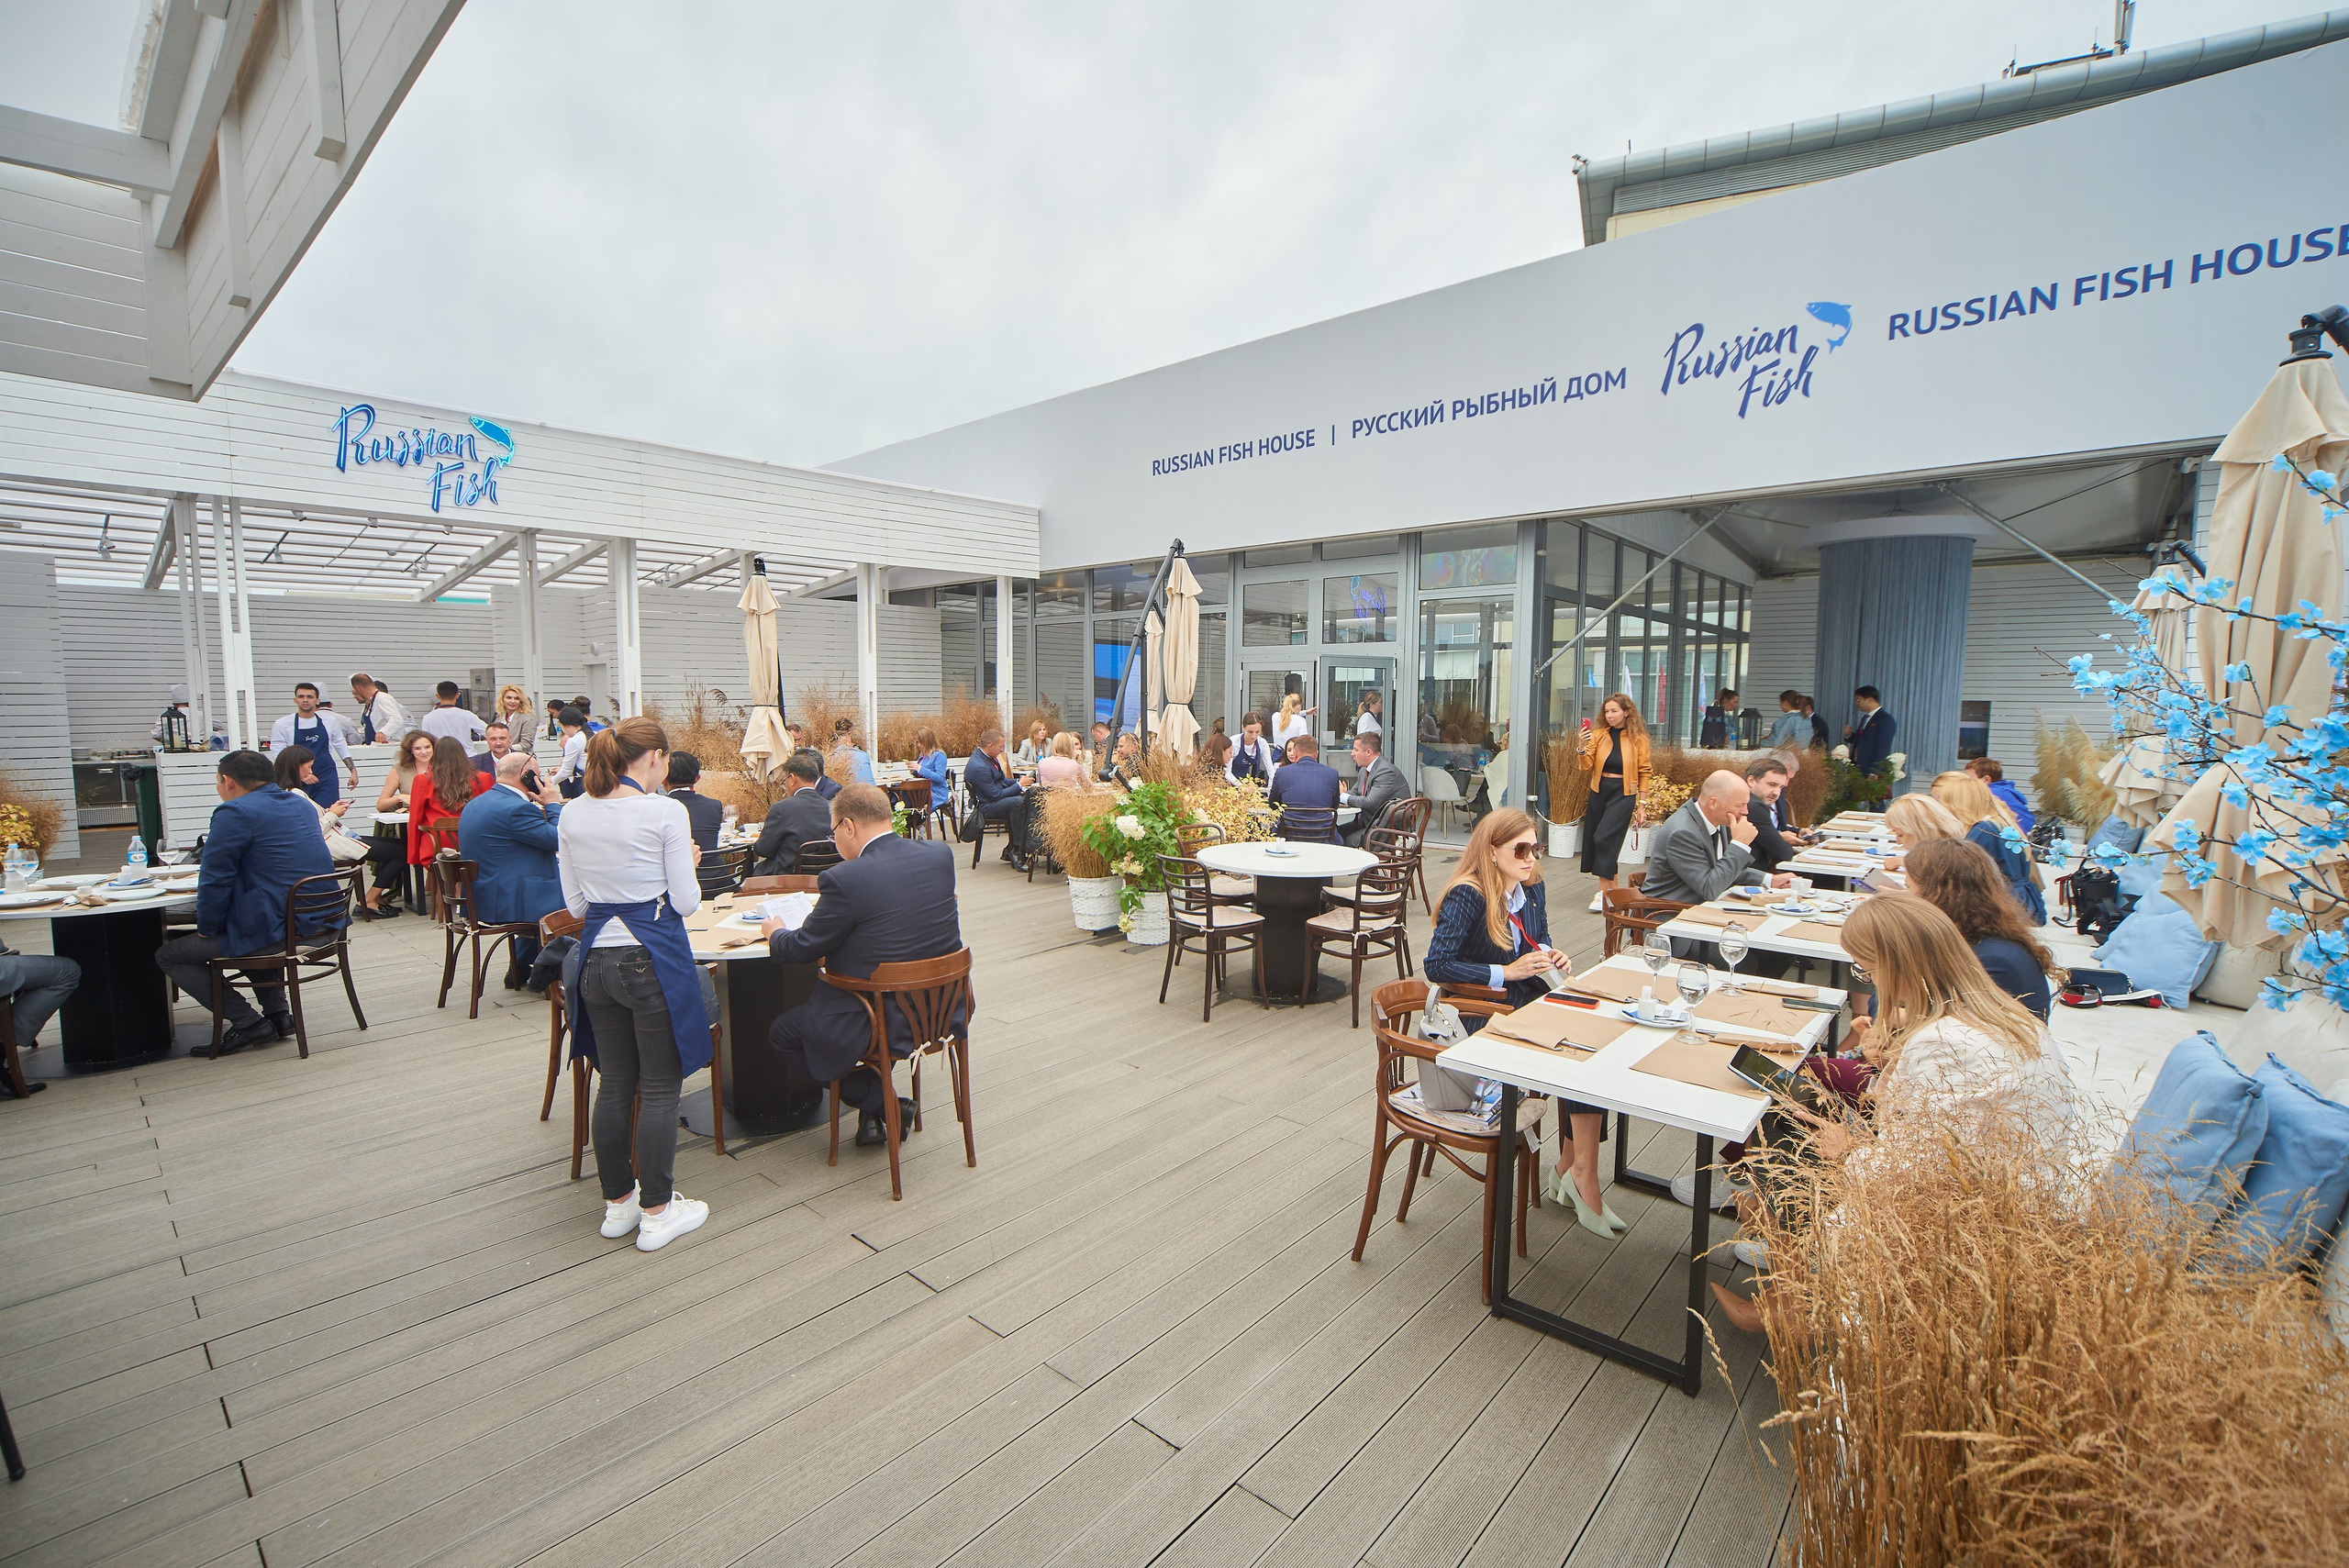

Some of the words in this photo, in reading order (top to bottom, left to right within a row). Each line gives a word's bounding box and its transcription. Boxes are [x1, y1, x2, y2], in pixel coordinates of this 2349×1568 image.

[1889, 282, 2060, 340] RUSSIAN
[2075, 259, 2175, 306] FISH
[1661, 323, 1799, 395] Russian
[1740, 343, 1820, 419] Fish
[331, 404, 479, 473] Russian
[1152, 449, 1215, 476] RUSSIAN
[1219, 441, 1253, 464] FISH
[1258, 428, 1316, 457] HOUSE
[1352, 399, 1445, 439] РУССКИЙ
[1452, 377, 1557, 421] РЫБНЫЙ
[1563, 366, 1628, 404] ДОМ
[426, 457, 499, 514] Fish
